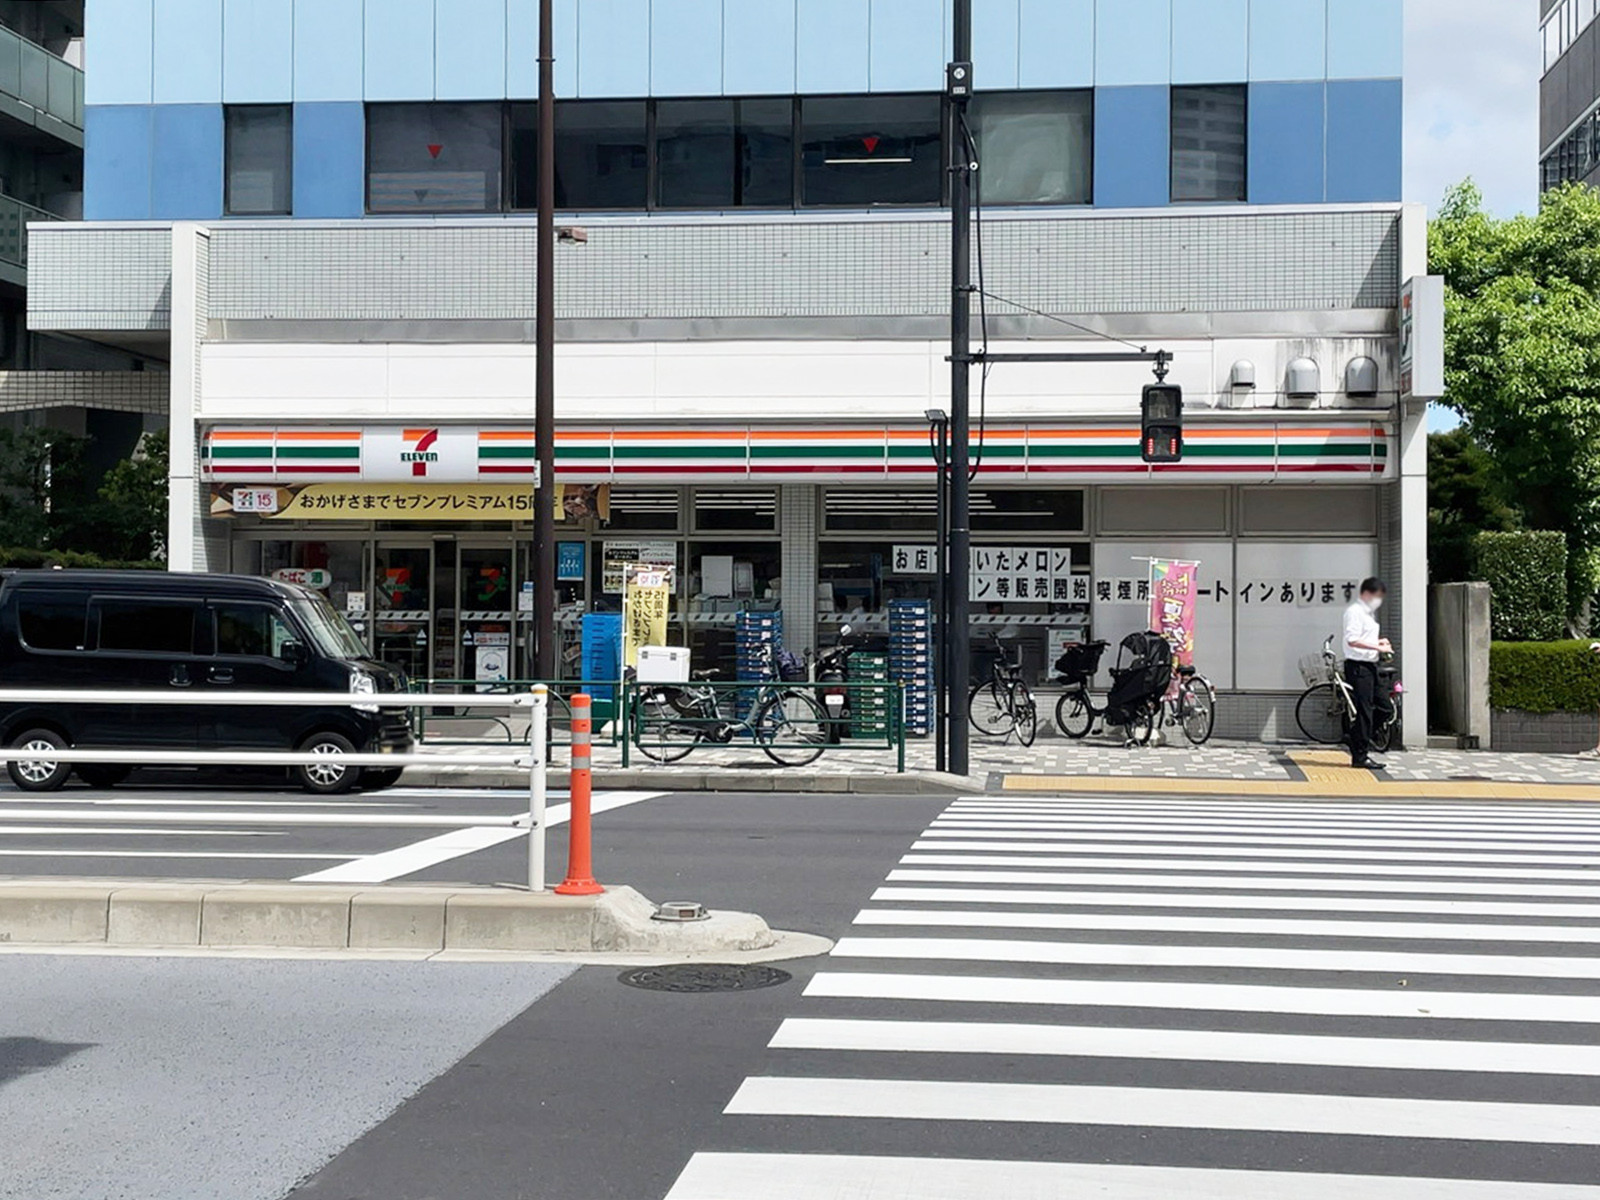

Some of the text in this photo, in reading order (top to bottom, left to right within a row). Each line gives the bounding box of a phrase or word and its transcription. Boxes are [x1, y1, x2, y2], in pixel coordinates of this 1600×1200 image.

[300, 494, 558, 510] おかげさまでセブンプレミアム15
[896, 550, 1067, 571] お店いたメロン
[279, 571, 306, 583] たばこ
[968, 578, 1086, 600] ン等販売開始
[1097, 580, 1357, 602] 喫煙所ートインあります
